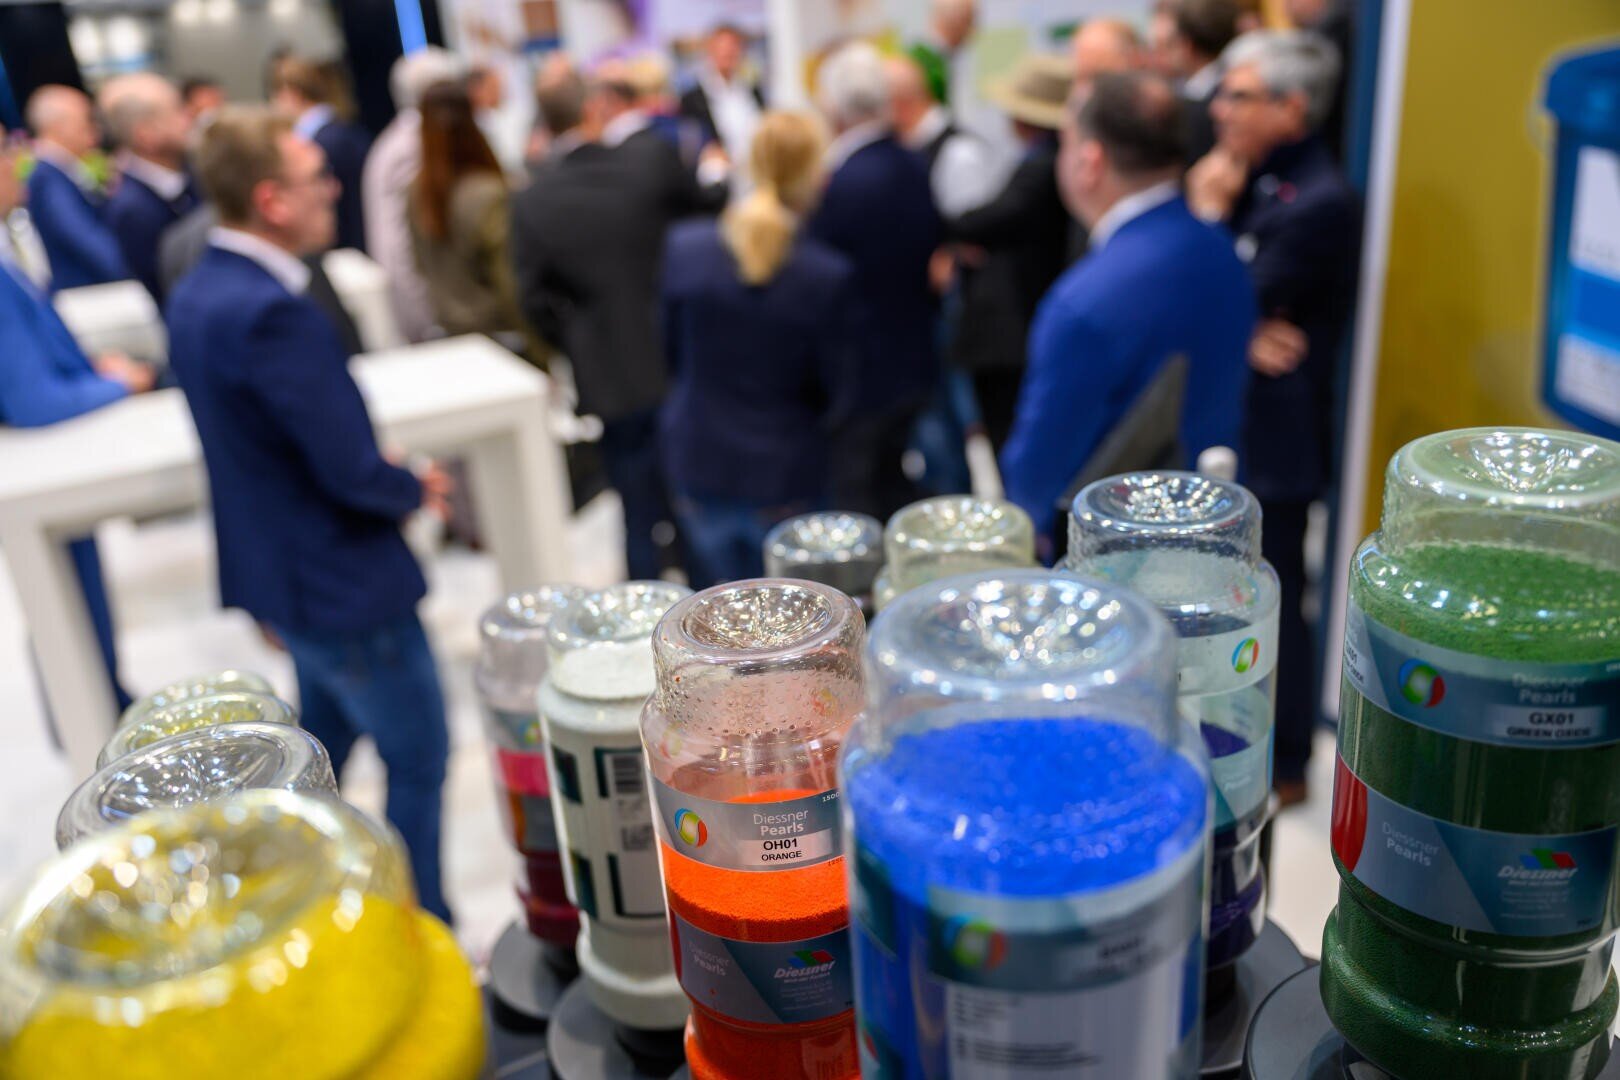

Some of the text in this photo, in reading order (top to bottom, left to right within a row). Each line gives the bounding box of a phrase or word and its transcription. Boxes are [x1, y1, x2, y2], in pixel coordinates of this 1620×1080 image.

[1519, 688, 1577, 705] Pearls
[1529, 711, 1575, 726] GX01
[753, 809, 809, 825] Diessner
[760, 821, 804, 837] Pearls
[763, 838, 798, 851] OH01
[1382, 821, 1441, 856] Diessner
[761, 850, 802, 862] ORANGE
[1386, 837, 1432, 867] Pearls
[774, 959, 837, 979] Diessner
